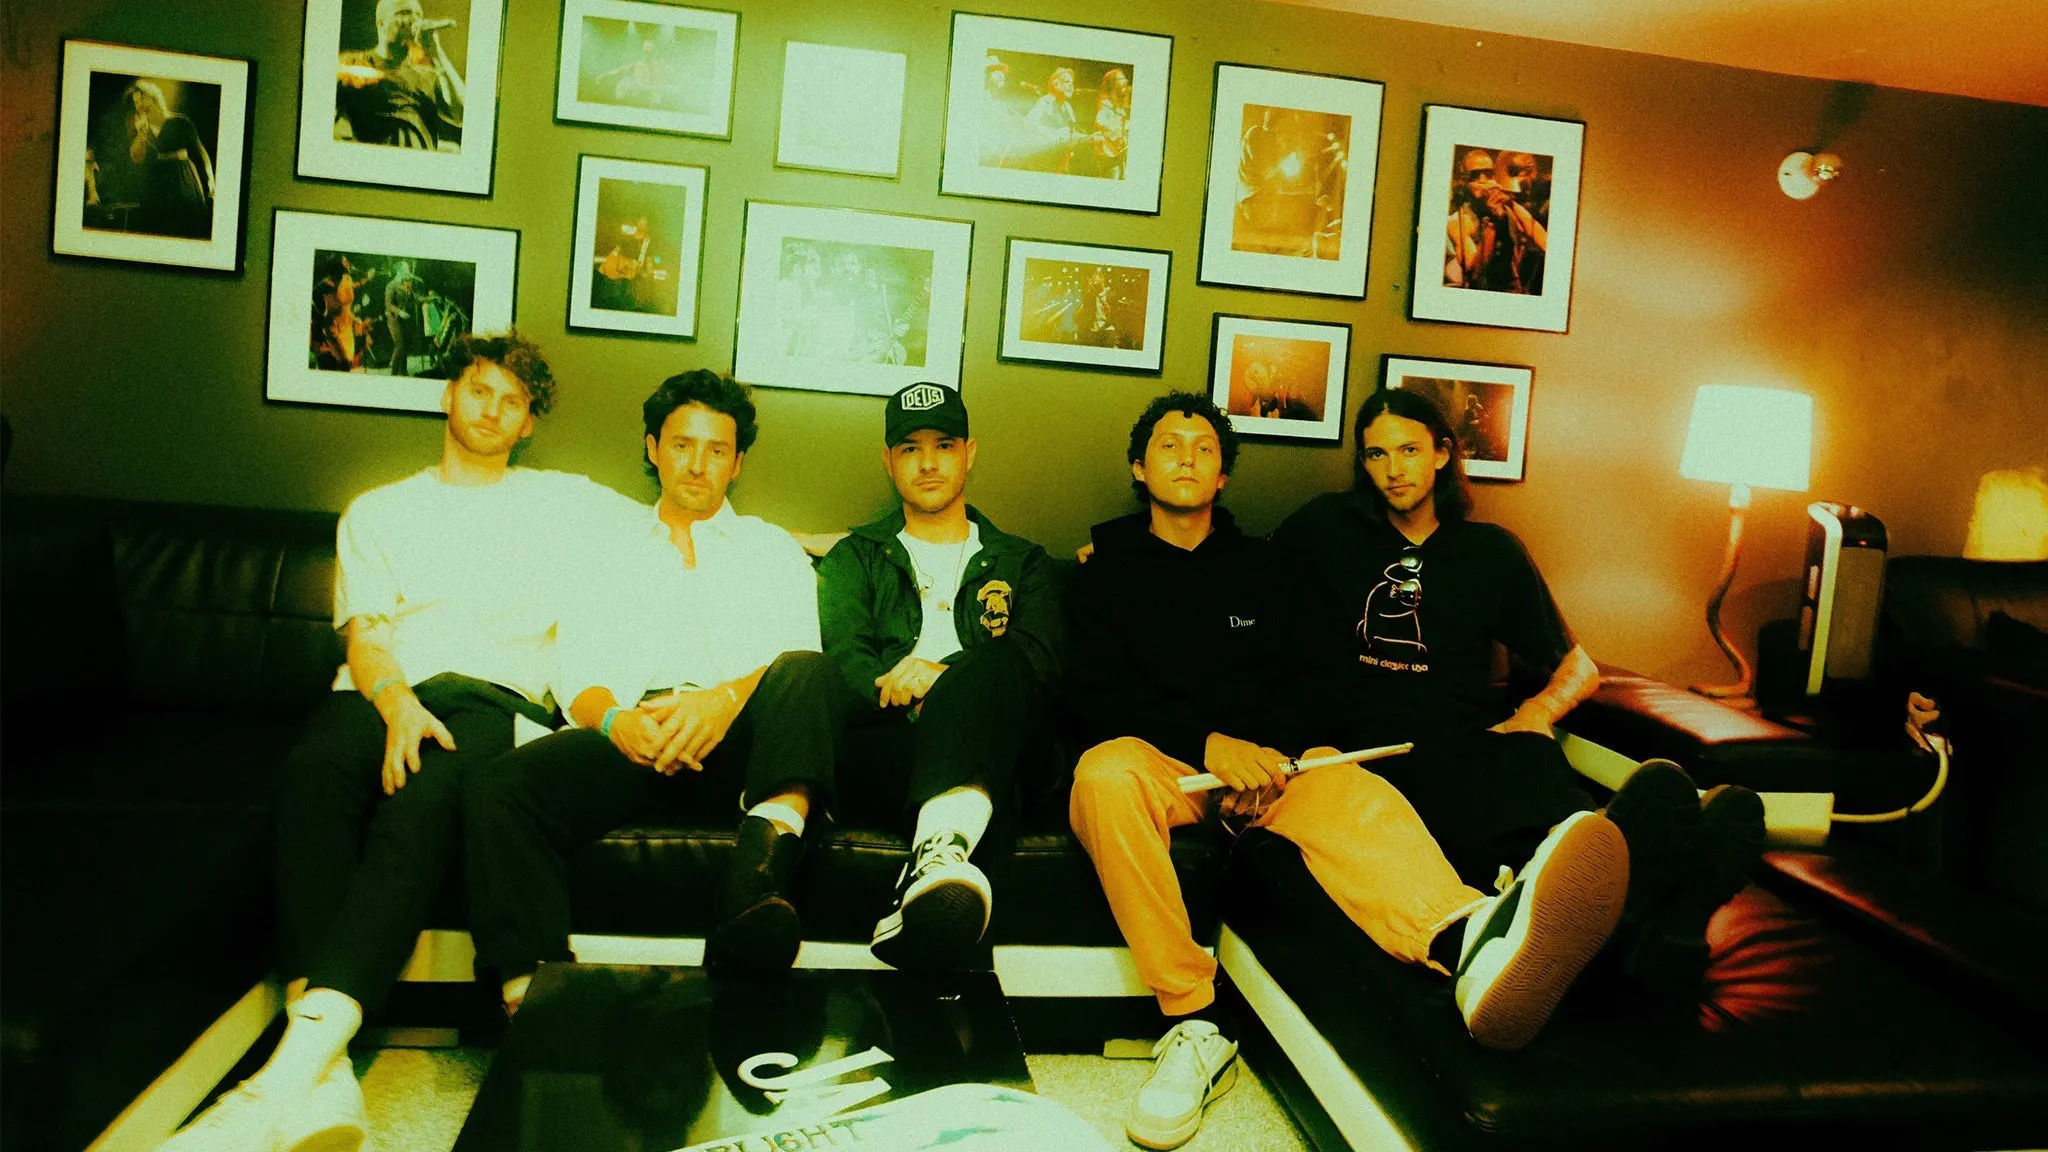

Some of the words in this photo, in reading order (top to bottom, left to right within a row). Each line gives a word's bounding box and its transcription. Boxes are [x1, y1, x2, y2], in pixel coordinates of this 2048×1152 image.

[905, 388, 940, 408] DEUS
[1229, 616, 1255, 628] Dime
[1359, 654, 1379, 666] mini
